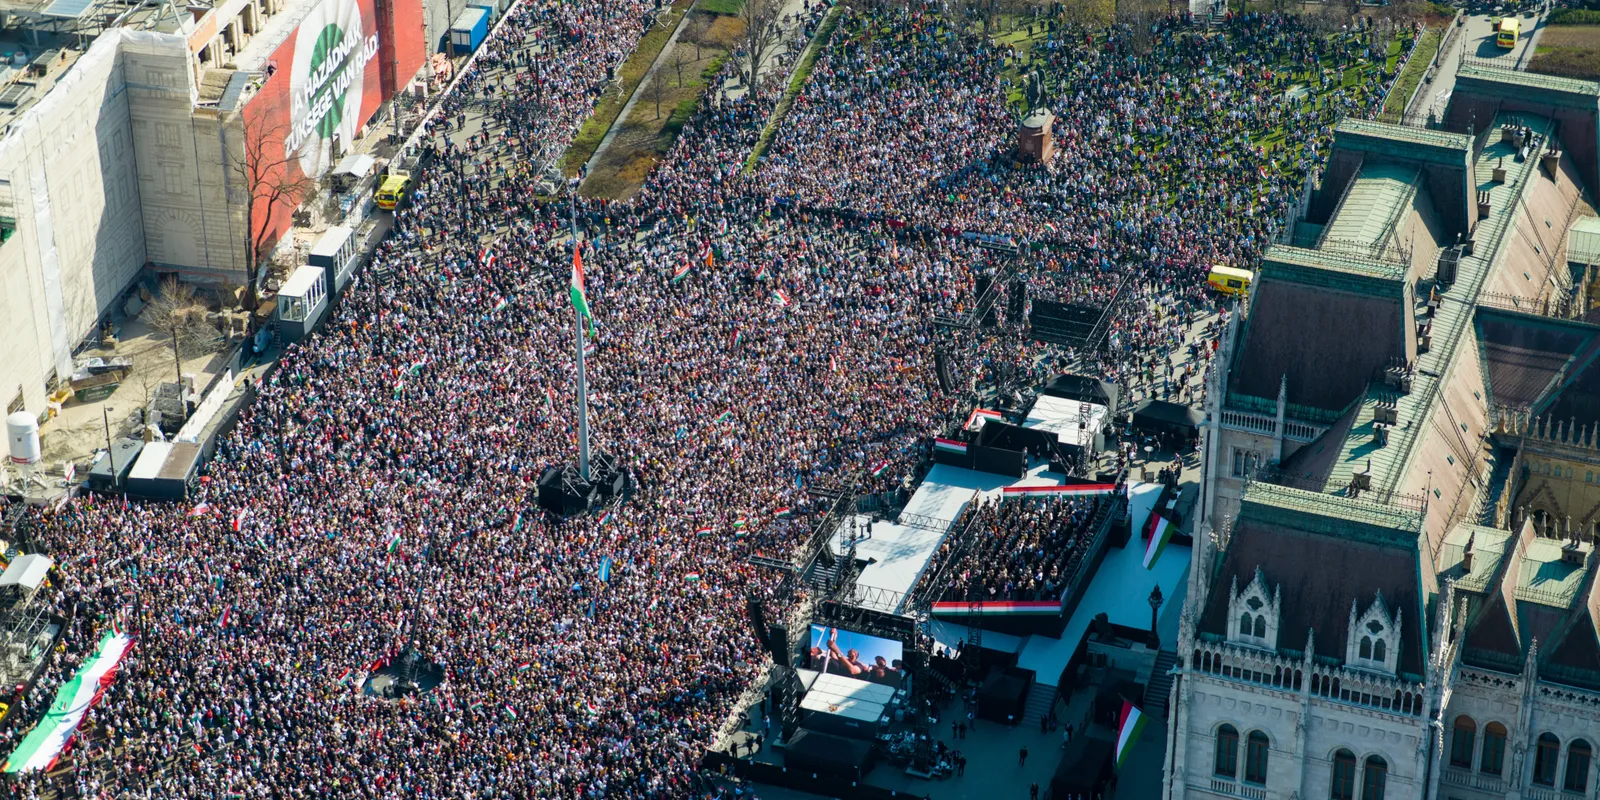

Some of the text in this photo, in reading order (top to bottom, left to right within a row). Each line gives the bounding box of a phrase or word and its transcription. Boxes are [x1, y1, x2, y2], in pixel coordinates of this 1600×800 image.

[294, 22, 363, 116] A HAZÁDNAK
[332, 62, 355, 99] VAN
